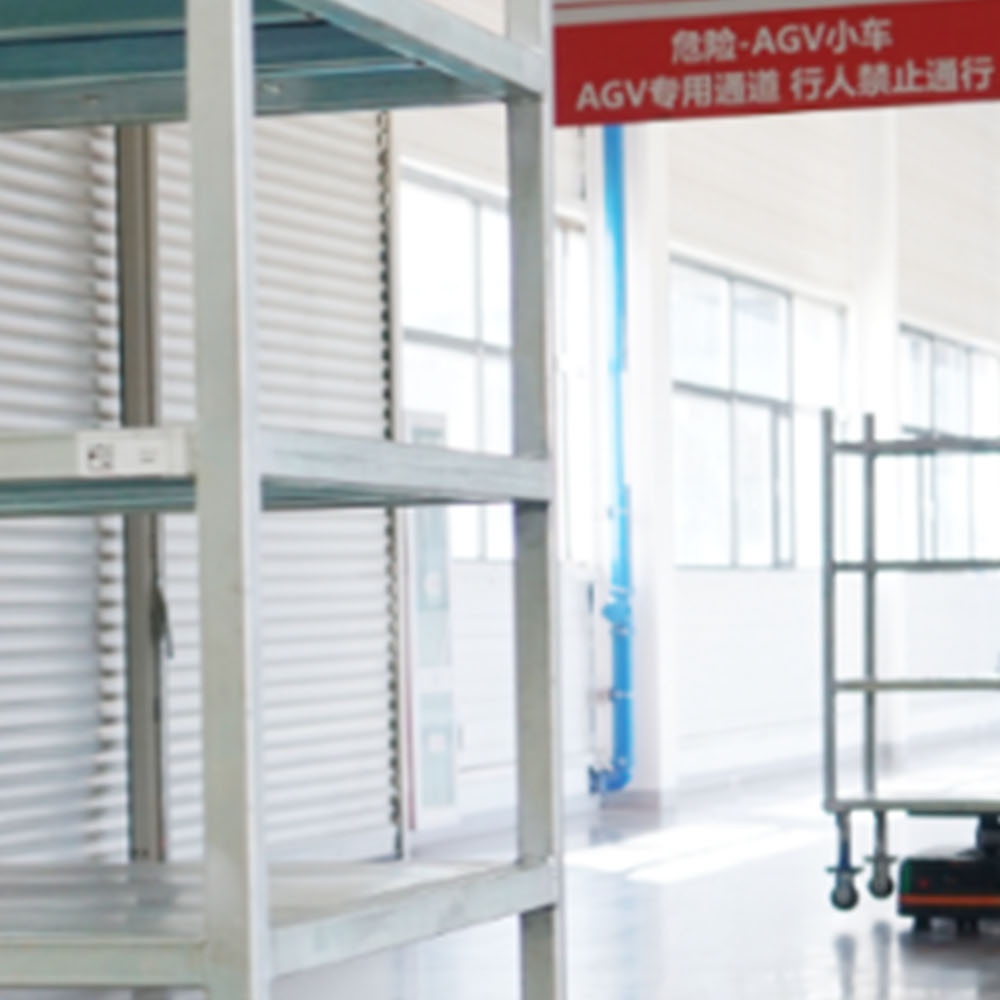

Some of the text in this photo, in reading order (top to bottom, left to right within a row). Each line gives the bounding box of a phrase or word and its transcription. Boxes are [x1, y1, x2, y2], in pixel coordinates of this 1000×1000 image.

[576, 55, 995, 111] AGV专用通道 行人禁止通行
